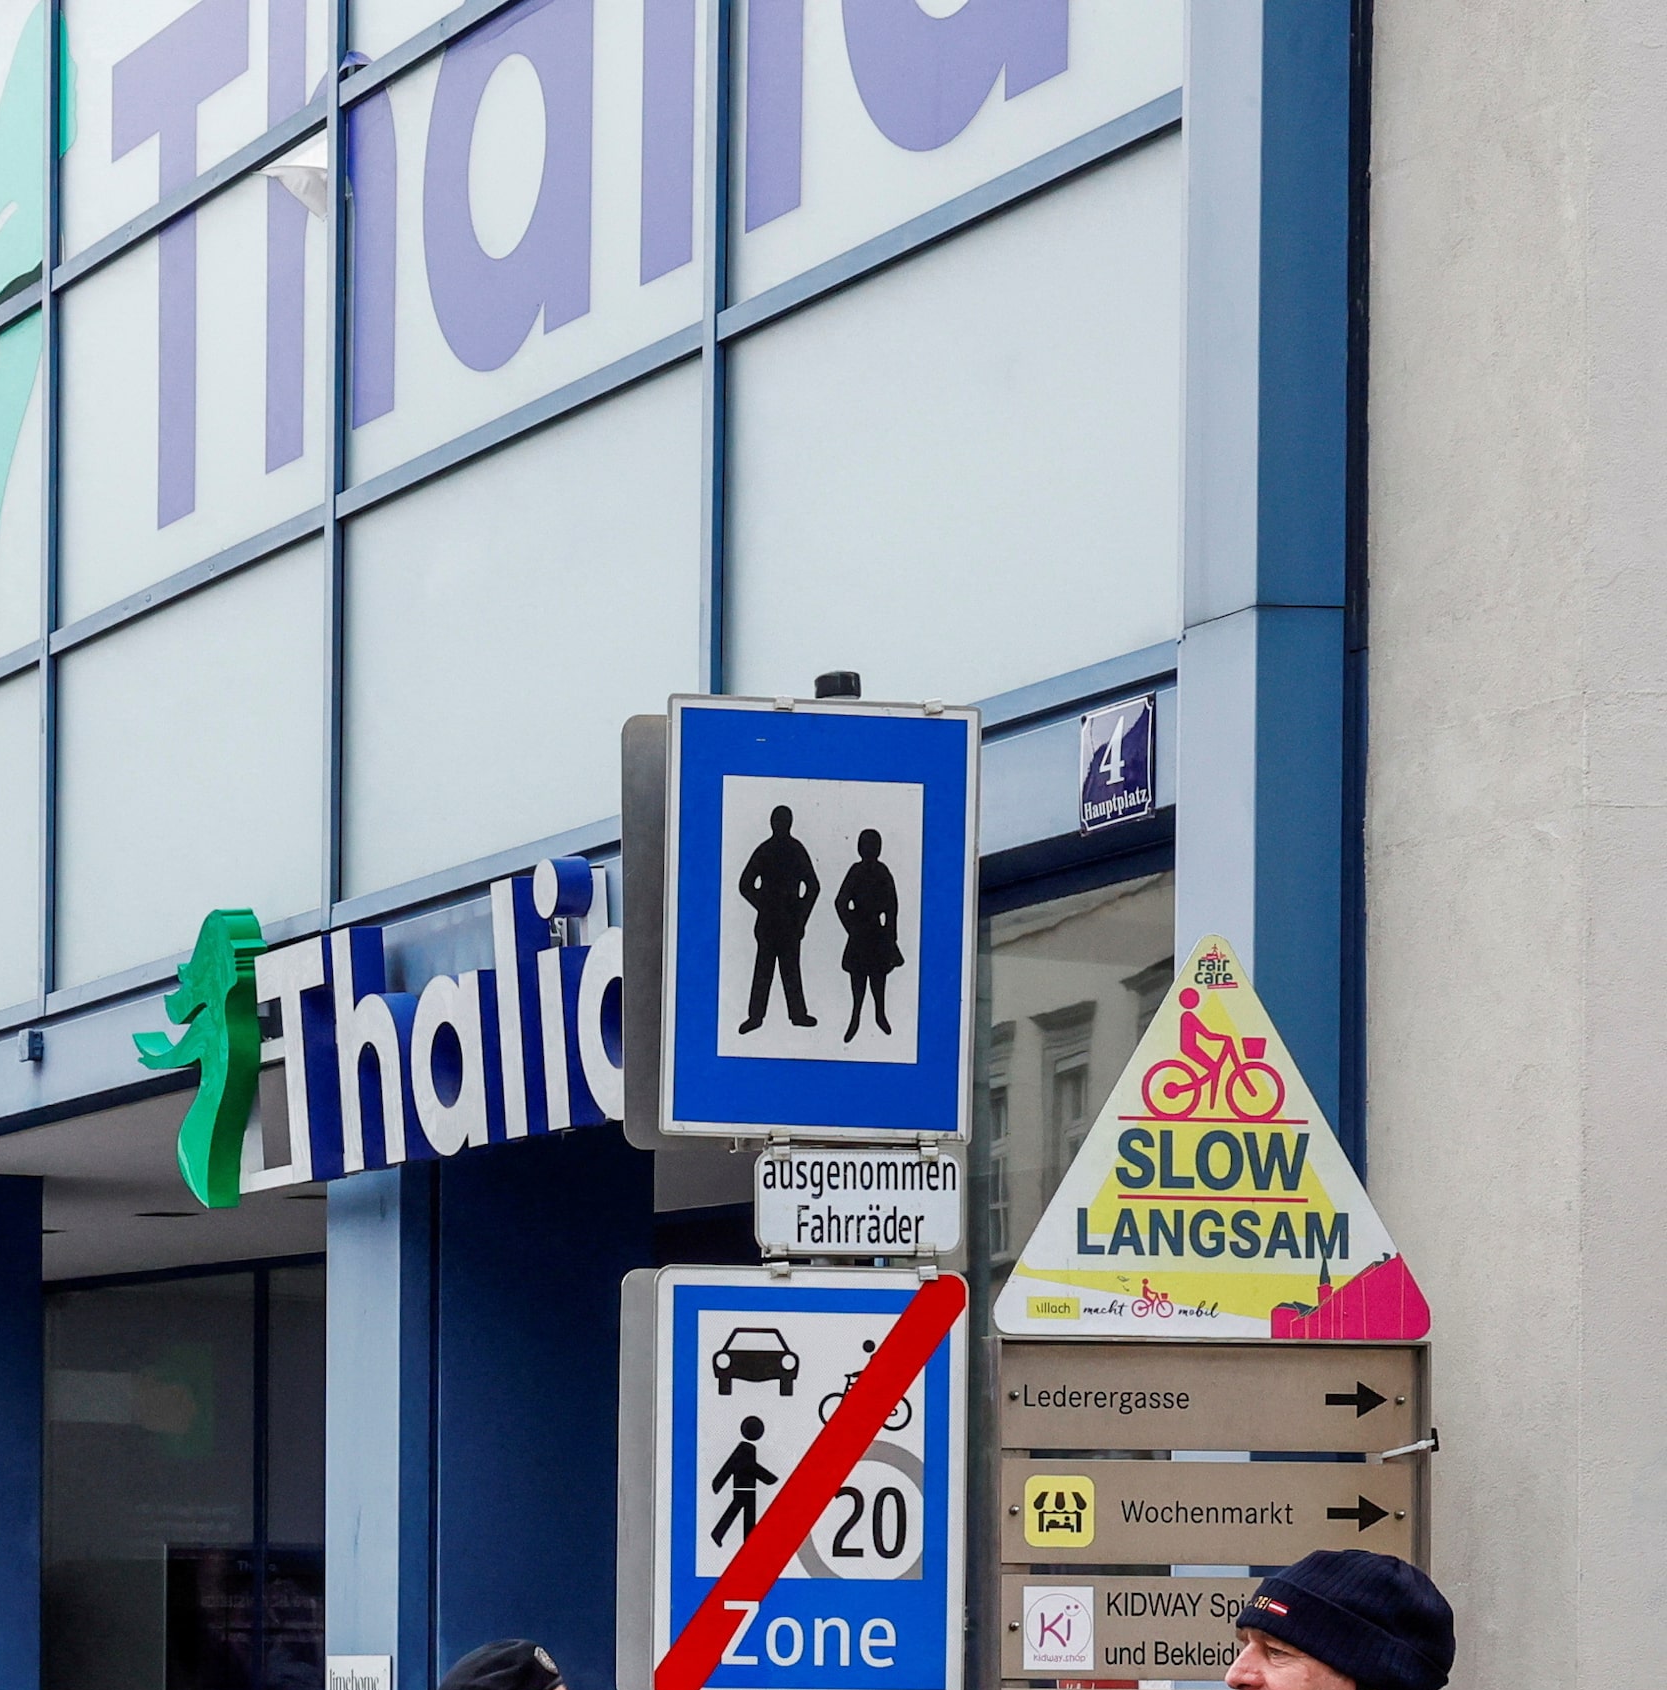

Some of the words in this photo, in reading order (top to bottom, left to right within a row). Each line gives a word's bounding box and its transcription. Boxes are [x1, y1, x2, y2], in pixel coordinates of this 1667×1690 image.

[1099, 715, 1125, 785] 4
[1084, 786, 1148, 821] Hauptplatz
[763, 1160, 956, 1199] ausgenommen
[1115, 1130, 1309, 1191] SLOW
[797, 1204, 925, 1244] Fahrräder
[1077, 1209, 1349, 1260] LANGSAM
[1083, 1299, 1125, 1317] macht
[1178, 1300, 1219, 1318] mobil
[1023, 1384, 1190, 1414] Lederergasse
[832, 1486, 907, 1560] 20
[1121, 1499, 1294, 1525] Wochenmarkt
[1106, 1592, 1203, 1617] KIDWAY
[1210, 1592, 1245, 1624] Spi
[720, 1600, 897, 1668] Zone
[1105, 1641, 1146, 1666] und
